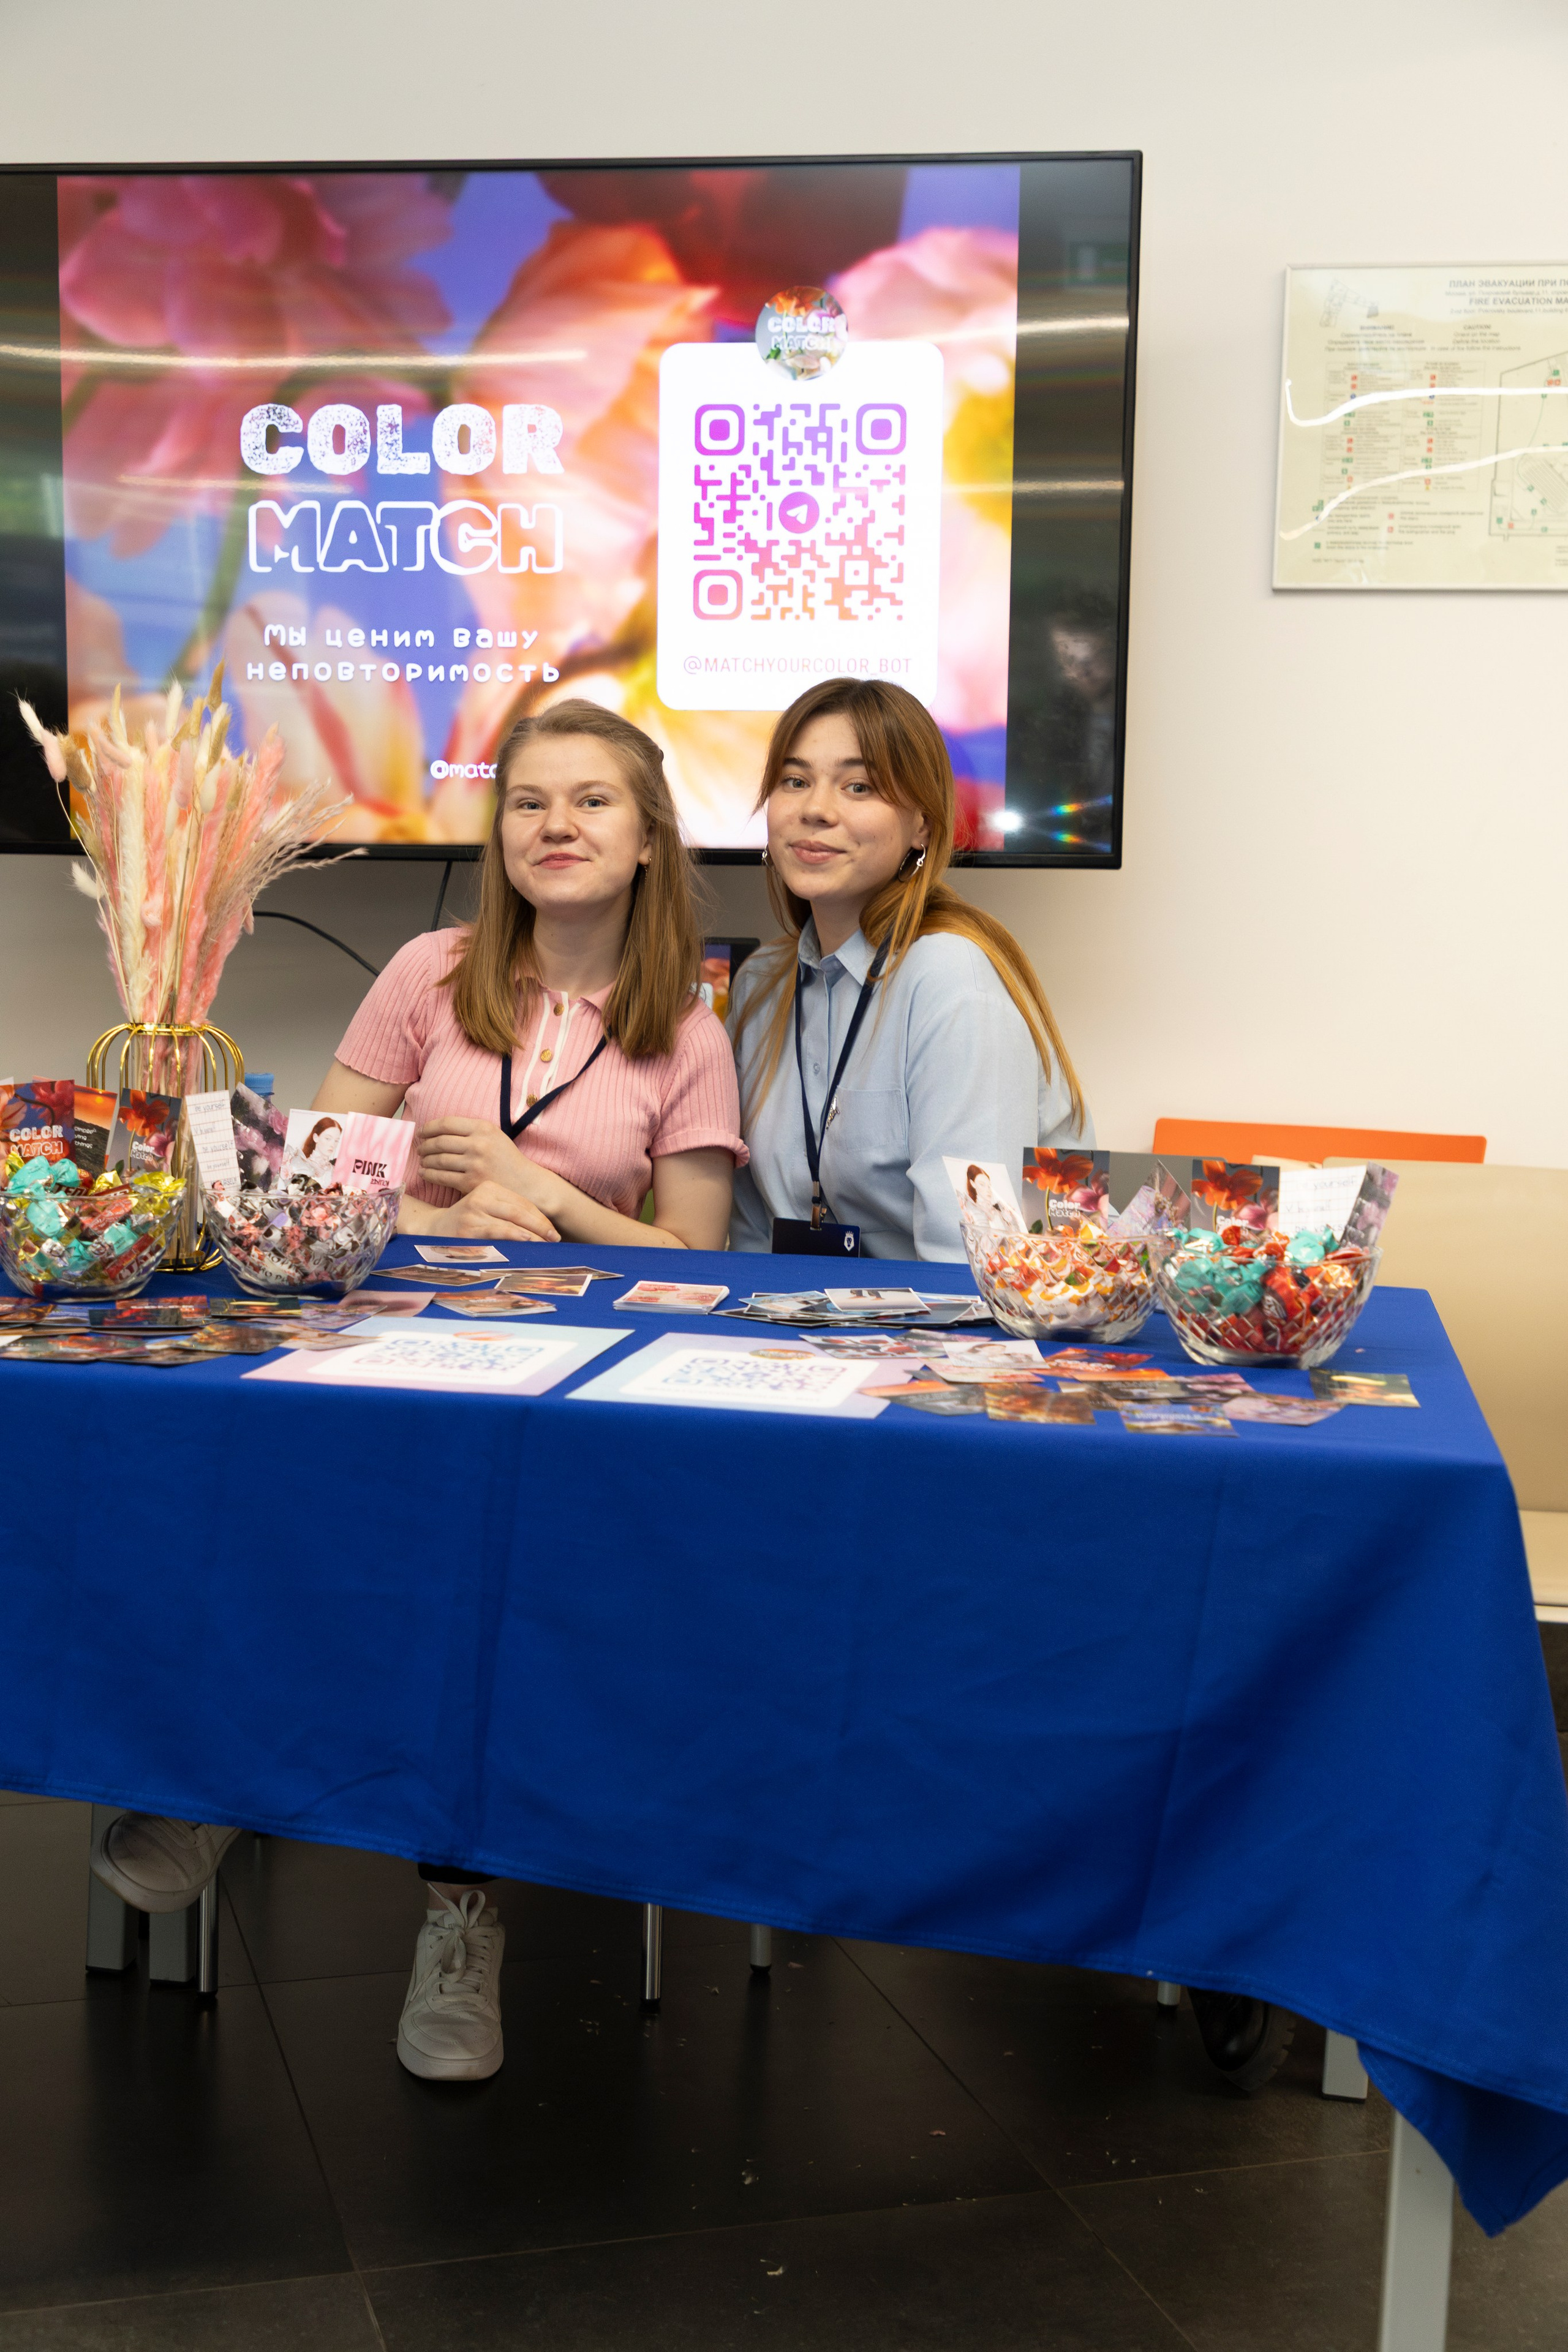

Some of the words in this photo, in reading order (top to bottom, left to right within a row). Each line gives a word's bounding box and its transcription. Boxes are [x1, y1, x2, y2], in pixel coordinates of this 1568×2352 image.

[1449, 279, 1476, 288] ПЛАН
[1478, 279, 1535, 288] ЭВАКУАЦИИ
[1537, 279, 1557, 288] ПРИ
[1469, 296, 1489, 306] FIRE
[1493, 296, 1553, 305] EVACUATION
[767, 315, 835, 334] COLOR
[771, 334, 831, 350] MATCH
[239, 402, 565, 475] COLOR
[248, 499, 564, 575] MATCH
[263, 623, 307, 647] Мы
[325, 627, 435, 649] ценим
[246, 661, 560, 684] неповторимость
[683, 655, 912, 676] @MATCHYOURCOLOR_BOT
[9, 1125, 63, 1142] COLOR
[10, 1141, 63, 1158] MATCH
[132, 1141, 155, 1153] Color
[130, 1150, 154, 1162] Match
[352, 1159, 387, 1178] PINK
[370, 1178, 390, 1187] EDITION
[1048, 1207, 1081, 1218] Match
[1049, 1199, 1081, 1210] Color
[1216, 1215, 1250, 1227] Color
